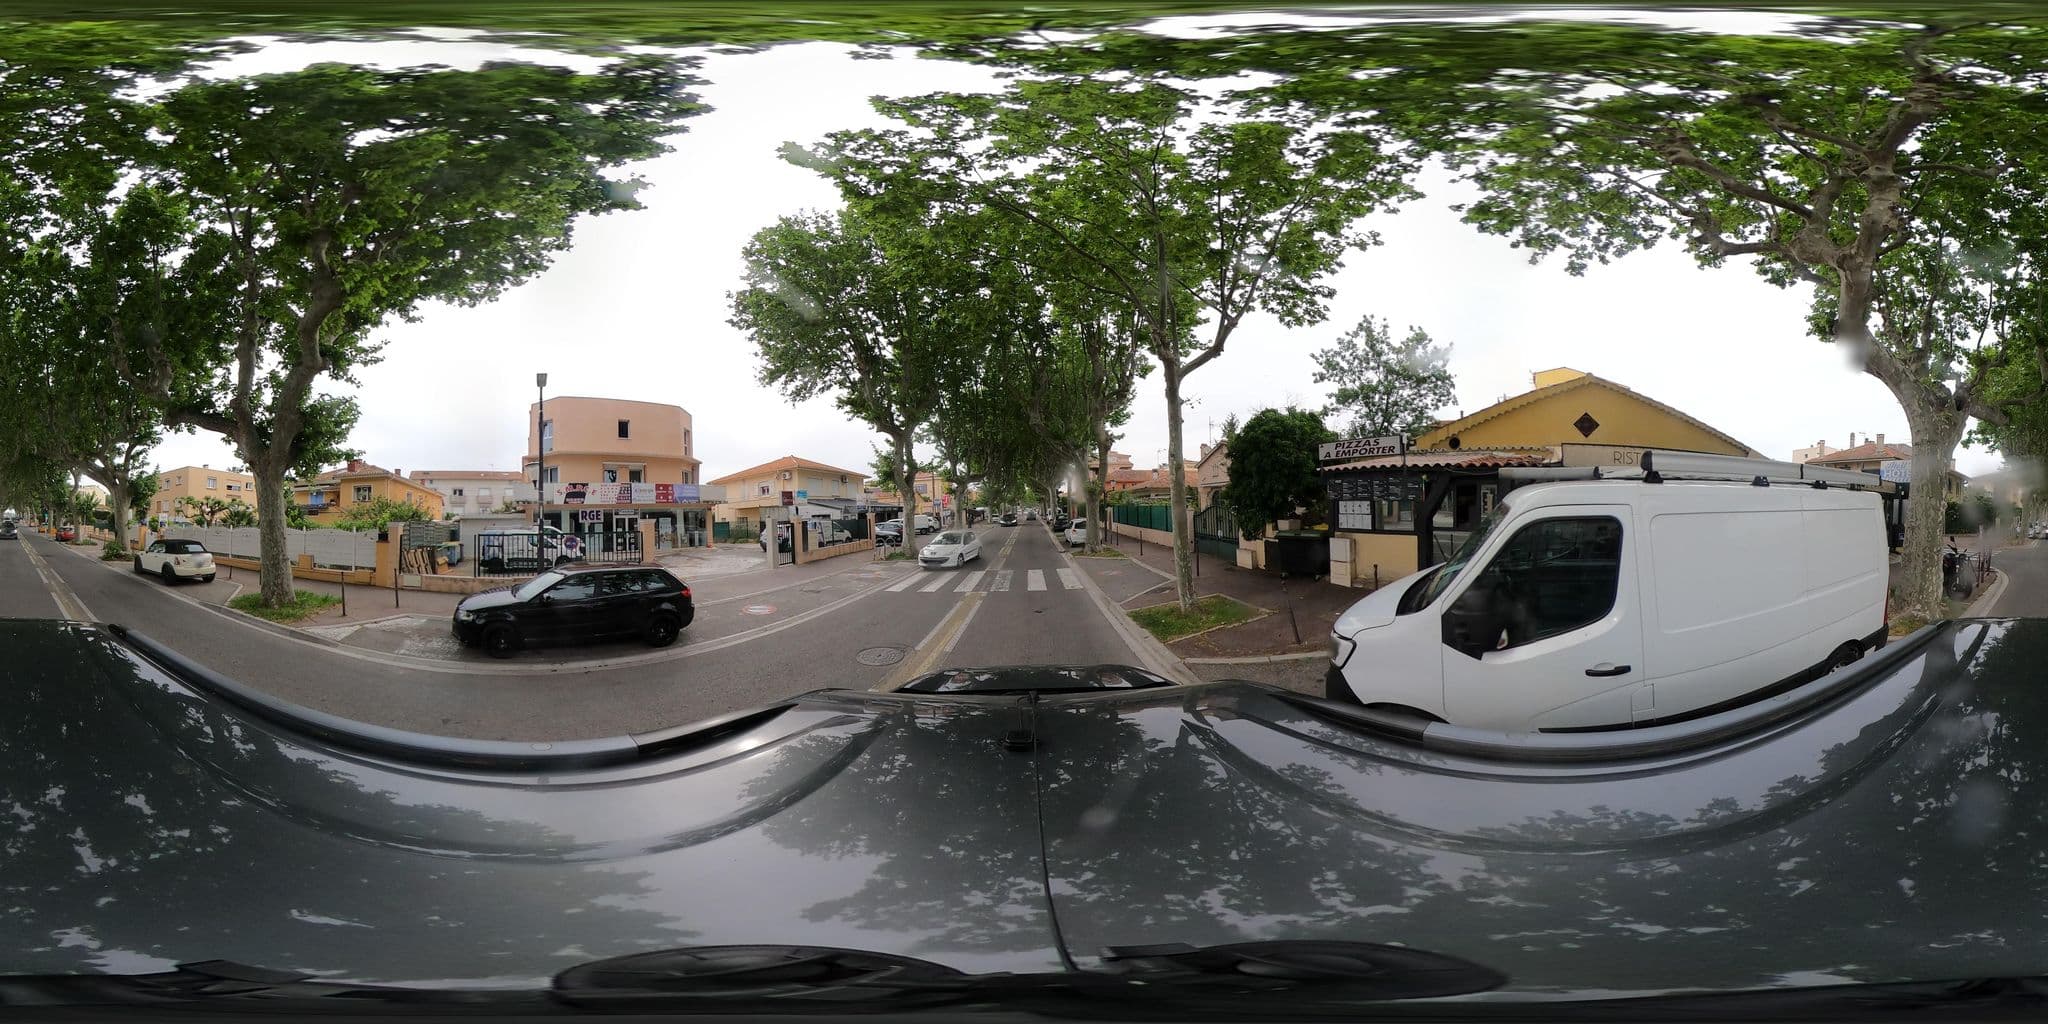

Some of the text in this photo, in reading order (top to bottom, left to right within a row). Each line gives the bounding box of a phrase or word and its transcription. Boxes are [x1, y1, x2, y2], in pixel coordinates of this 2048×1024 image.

[1334, 438, 1380, 450] PIZZAS
[1323, 445, 1396, 459] A EMPORTER
[580, 510, 601, 521] RGE
